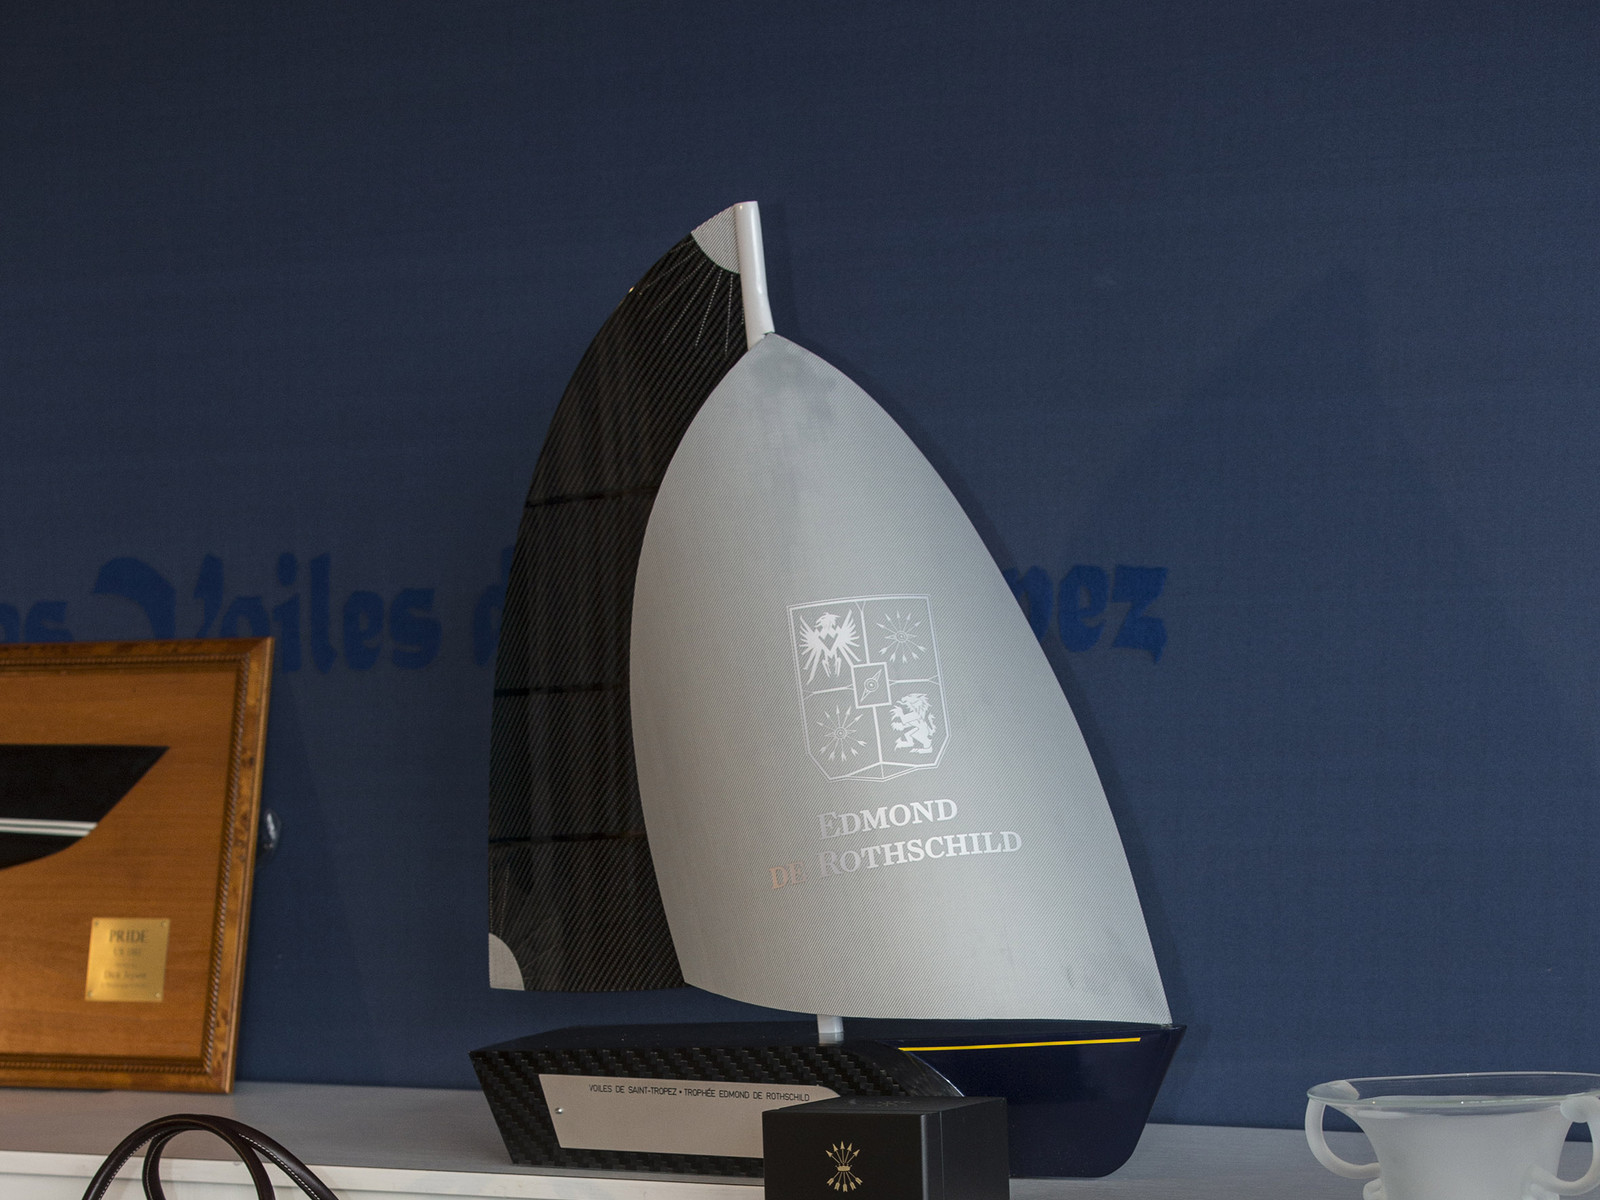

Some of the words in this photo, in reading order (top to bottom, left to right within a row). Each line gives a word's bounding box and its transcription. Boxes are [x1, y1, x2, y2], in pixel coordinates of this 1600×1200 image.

[816, 798, 958, 841] EDMOND
[769, 861, 807, 890] DE
[815, 829, 1023, 879] ROTHSCHILD
[588, 1084, 613, 1093] VOILES
[615, 1085, 625, 1094] DE
[628, 1085, 677, 1096] SAINT-TROPEZ
[684, 1087, 716, 1098] TROPHÉE
[719, 1089, 750, 1099] EDMOND
[753, 1091, 763, 1099] DE
[766, 1092, 810, 1102] ROTHSCHILD
